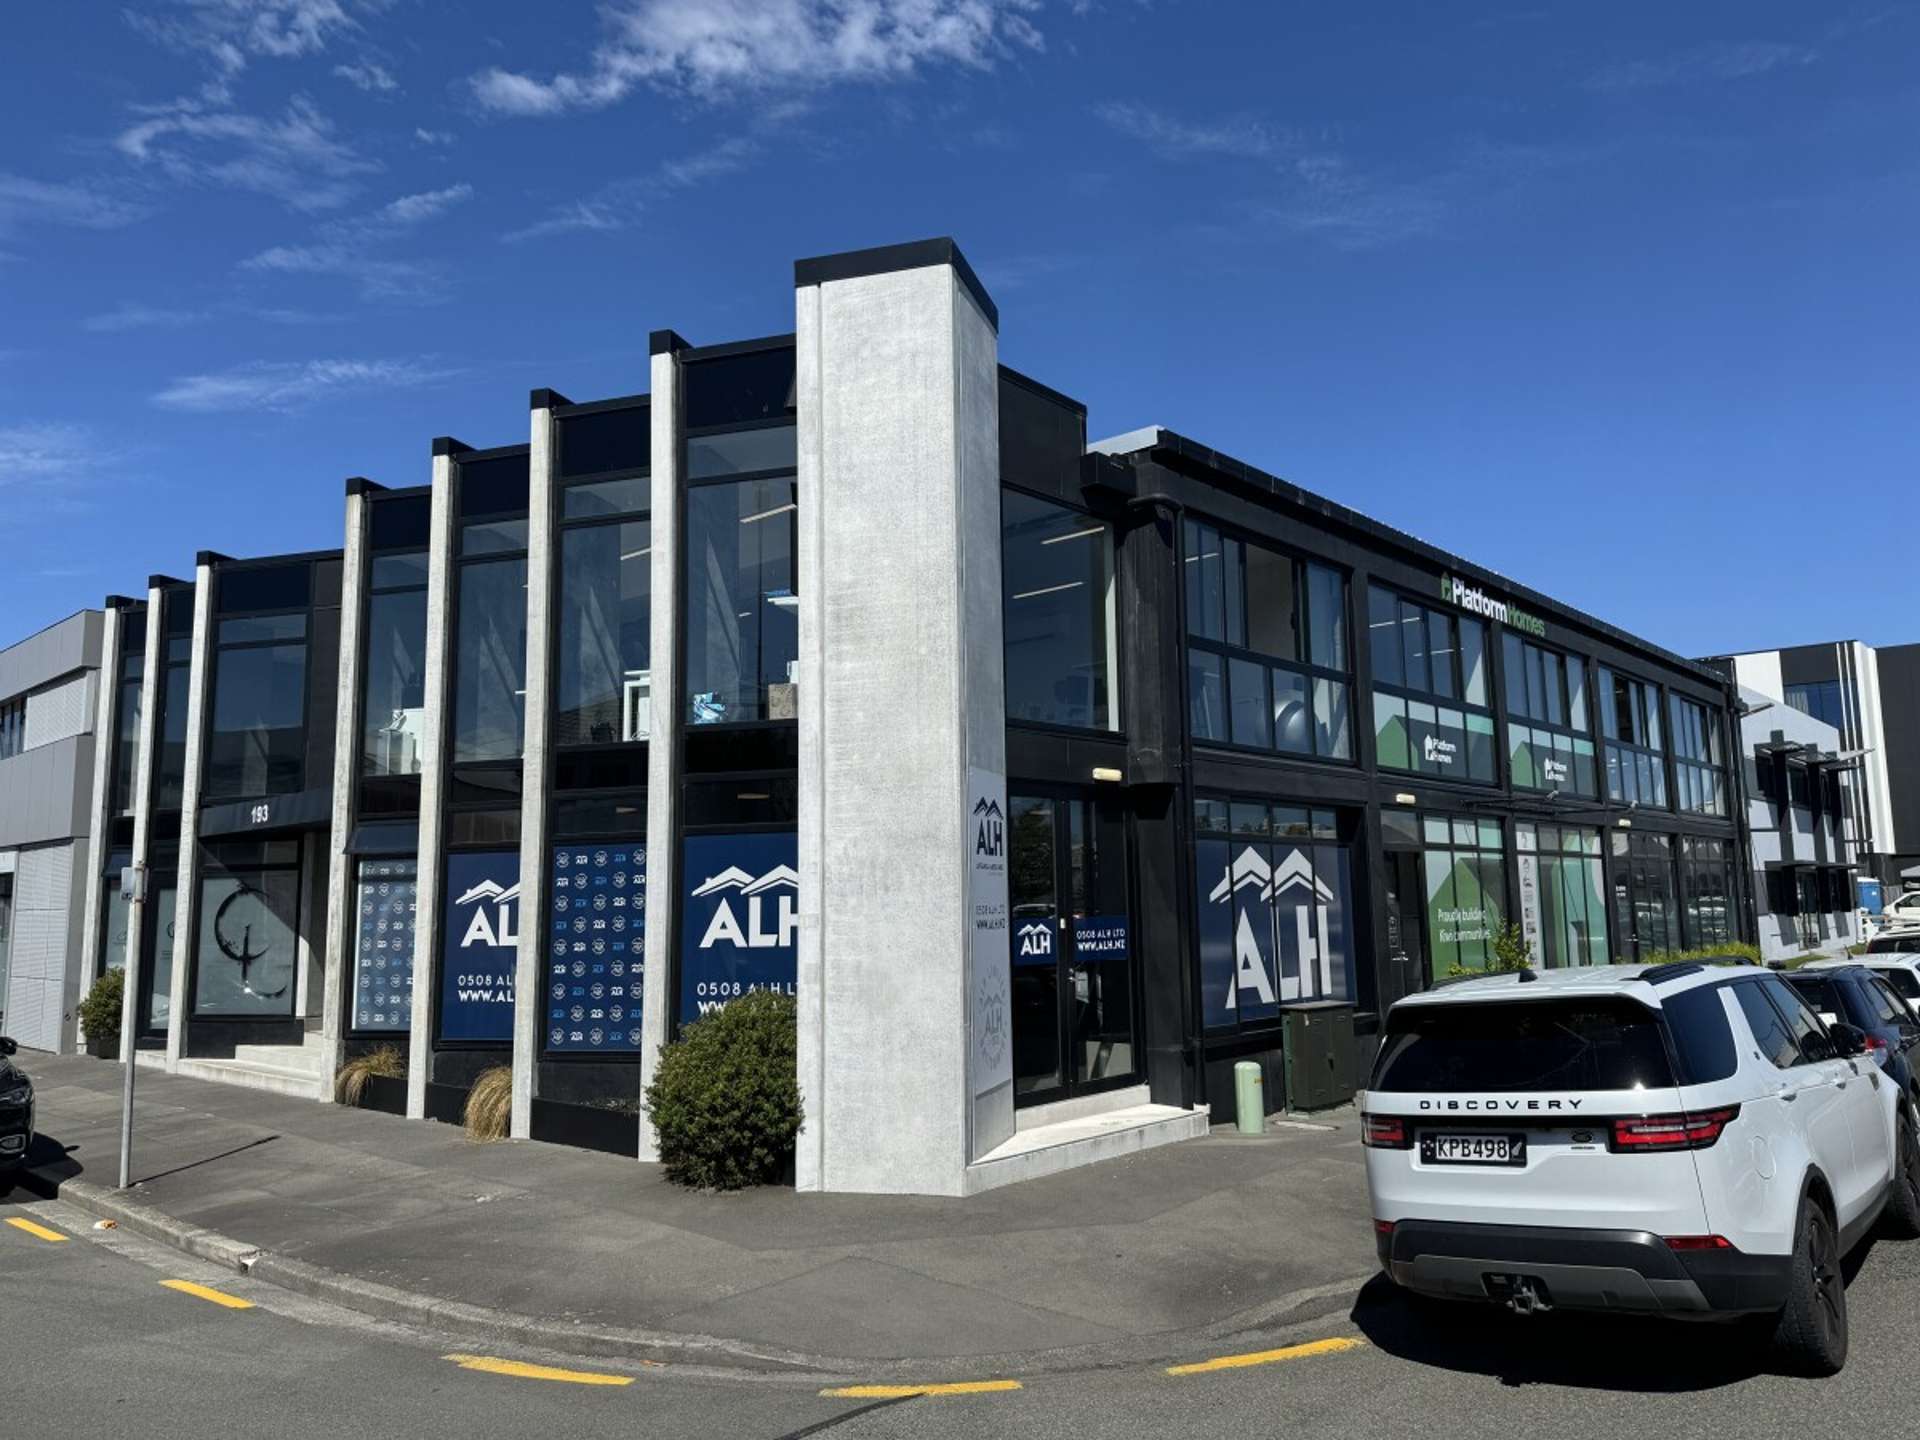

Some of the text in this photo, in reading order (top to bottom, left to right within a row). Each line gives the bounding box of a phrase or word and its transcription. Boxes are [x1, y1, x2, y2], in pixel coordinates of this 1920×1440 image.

[251, 804, 269, 823] 193
[976, 819, 1003, 857] ALH
[460, 904, 520, 947] AL
[1021, 934, 1051, 956] ALH
[1225, 905, 1333, 1009] ALH
[458, 975, 513, 986] 0508 AL
[697, 982, 741, 996] 0508
[458, 990, 515, 1003] WWW.AL
[1420, 1099, 1582, 1110] DISCOVERY
[1437, 1137, 1508, 1158] KPB498
